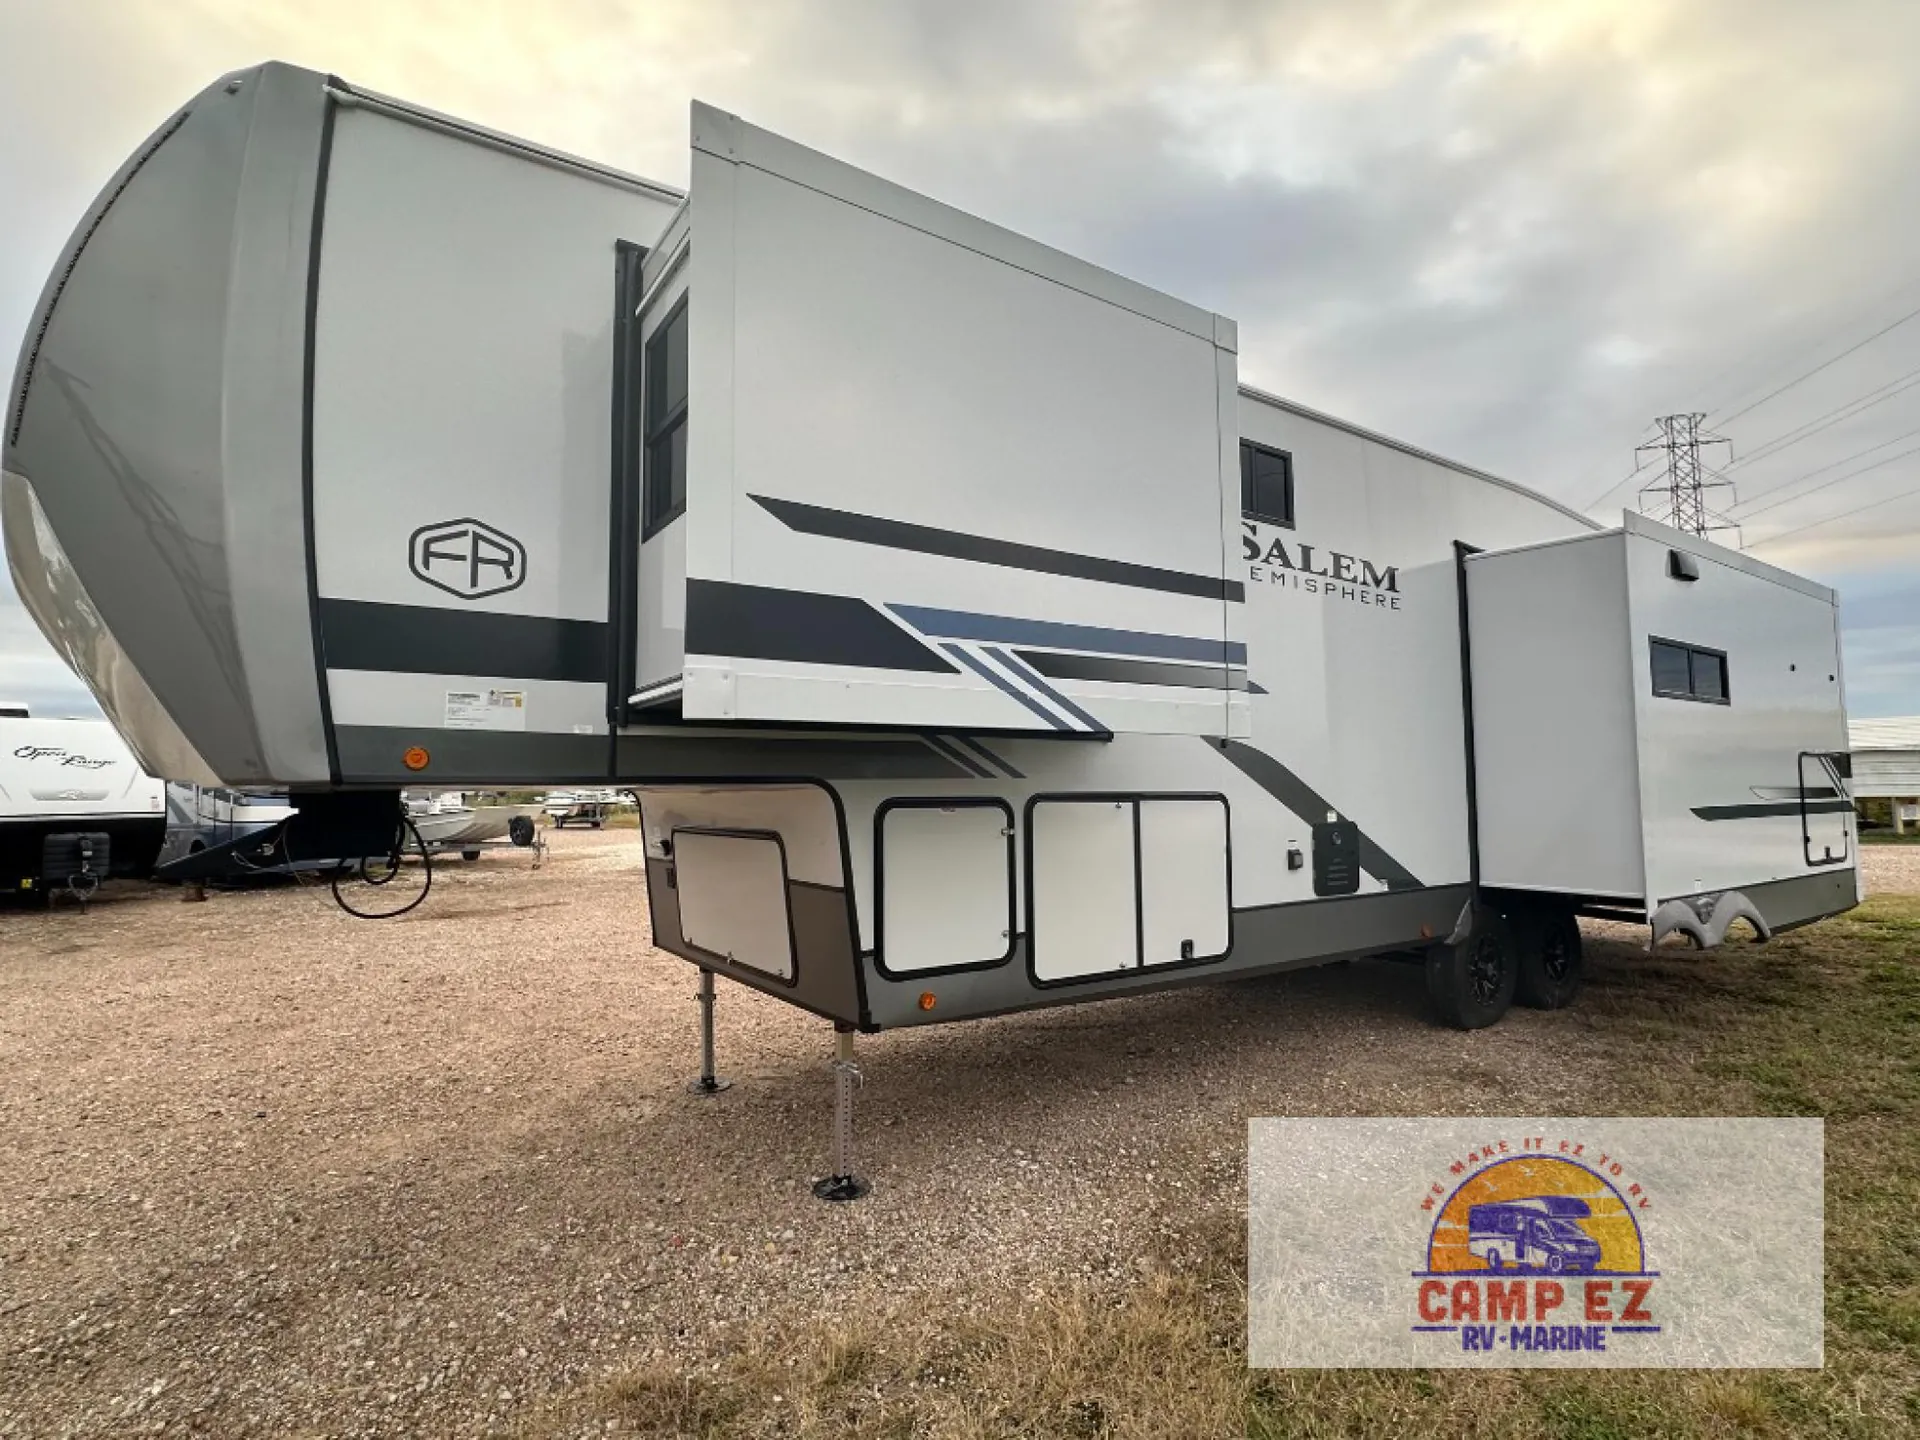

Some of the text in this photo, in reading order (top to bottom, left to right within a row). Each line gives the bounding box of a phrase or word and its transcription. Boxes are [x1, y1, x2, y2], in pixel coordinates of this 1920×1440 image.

[421, 529, 514, 589] FR
[1241, 521, 1400, 593] SALEM
[1250, 565, 1401, 611] EMISPHERE
